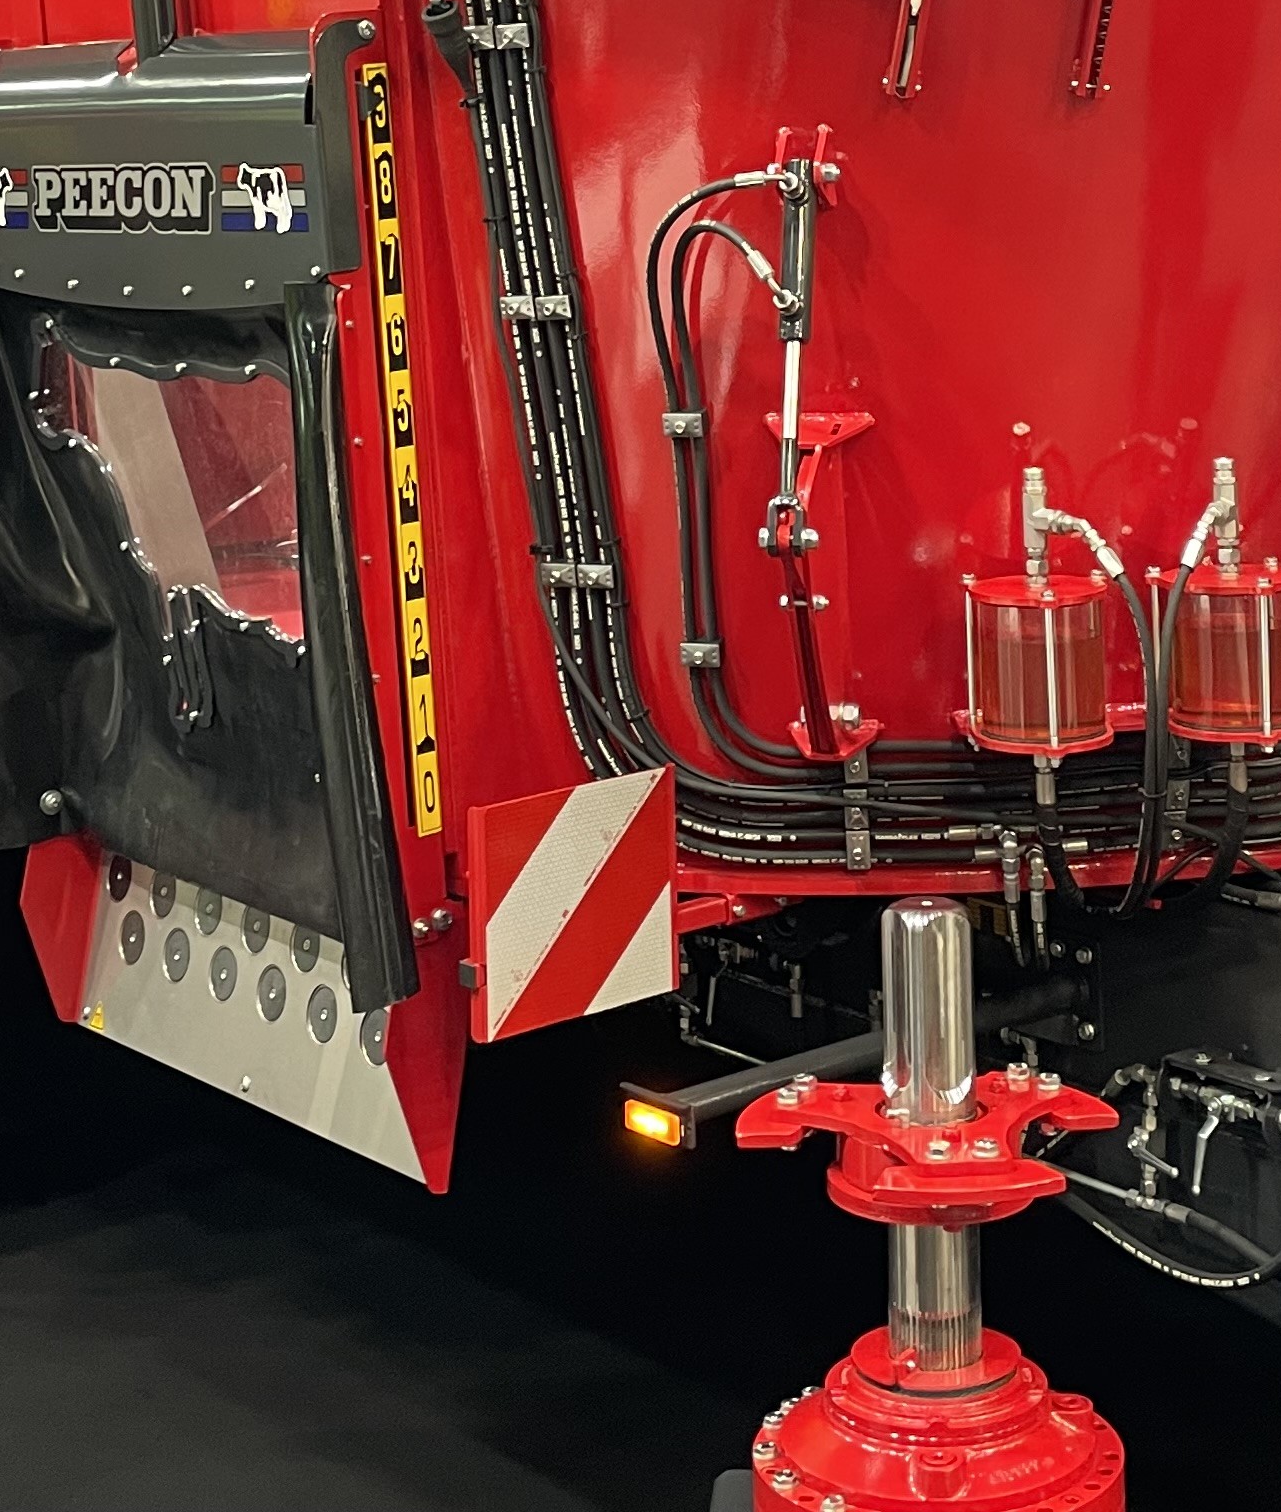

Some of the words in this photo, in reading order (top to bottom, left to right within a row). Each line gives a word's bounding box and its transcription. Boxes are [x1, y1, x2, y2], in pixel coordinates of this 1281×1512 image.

[33, 166, 208, 220] PEECON
[379, 159, 392, 205] 8
[384, 234, 396, 281] 7
[390, 312, 404, 357] 6
[396, 388, 409, 433] 5
[401, 463, 416, 508] 4
[407, 540, 421, 585] 3
[412, 616, 427, 661] 2
[418, 693, 431, 740] 1
[423, 769, 437, 814] 0
